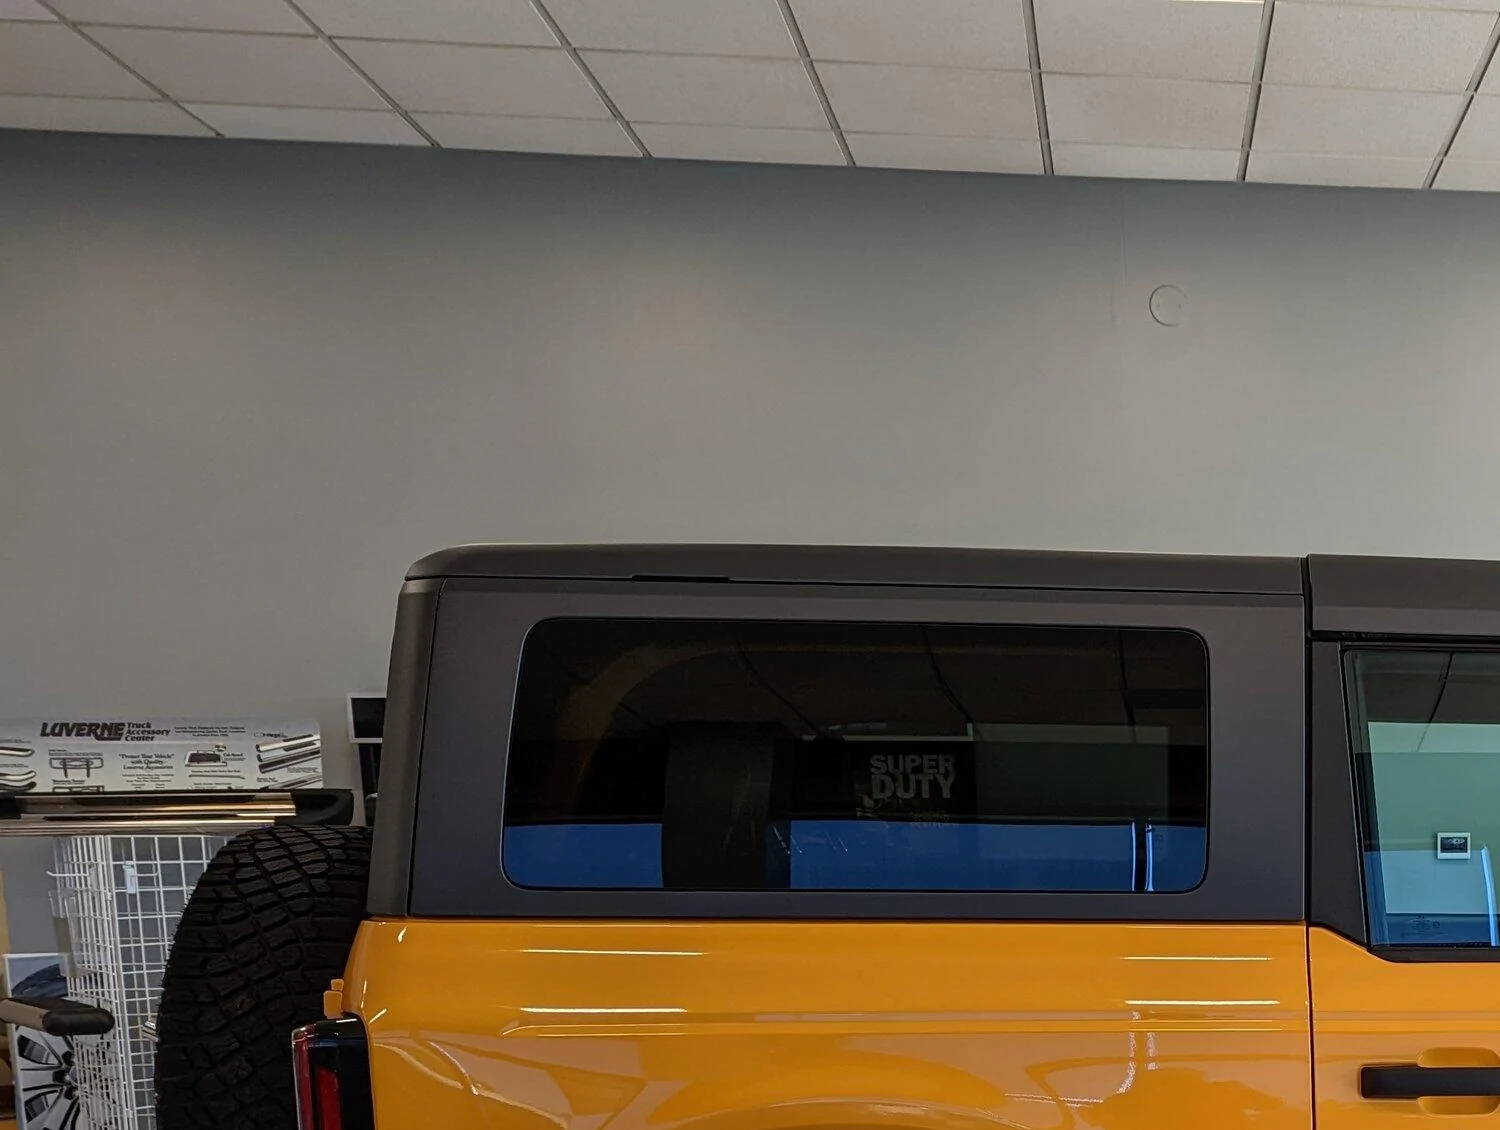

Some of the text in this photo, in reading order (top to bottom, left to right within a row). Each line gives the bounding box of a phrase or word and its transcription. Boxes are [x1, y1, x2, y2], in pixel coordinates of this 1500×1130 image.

[40, 721, 126, 741] LUVERNE
[125, 728, 171, 736] Accessory
[126, 721, 152, 729] Truck
[870, 754, 954, 774] SUPER
[871, 774, 956, 799] DUTY
